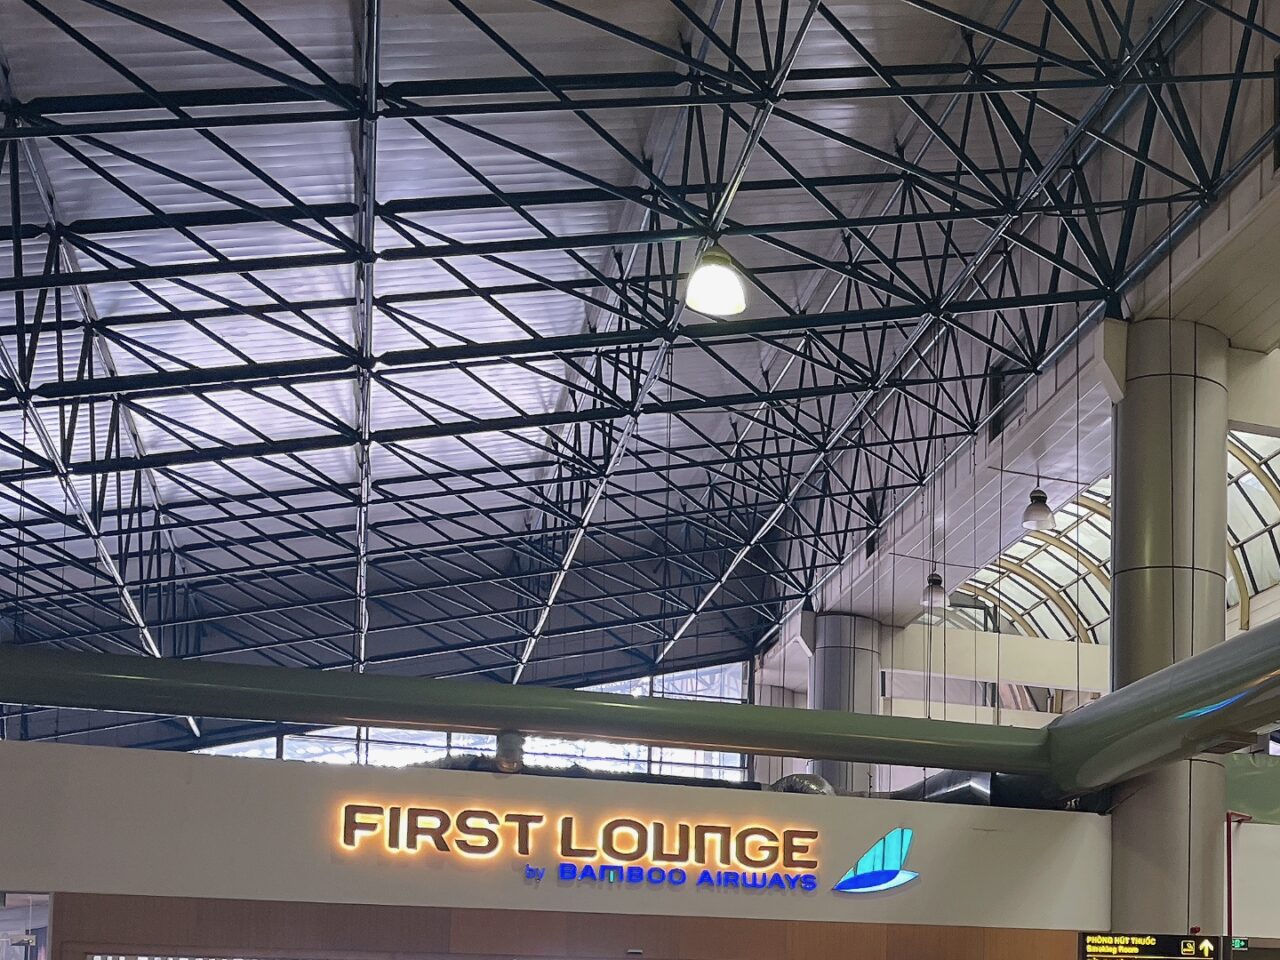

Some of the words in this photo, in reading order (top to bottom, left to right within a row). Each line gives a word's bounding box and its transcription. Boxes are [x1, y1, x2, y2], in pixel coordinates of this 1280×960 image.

[342, 803, 544, 856] FIRST
[560, 817, 819, 870] LOUNGE
[526, 863, 546, 882] by
[558, 862, 687, 886] BAMBOO
[696, 869, 818, 892] AIRWAYS
